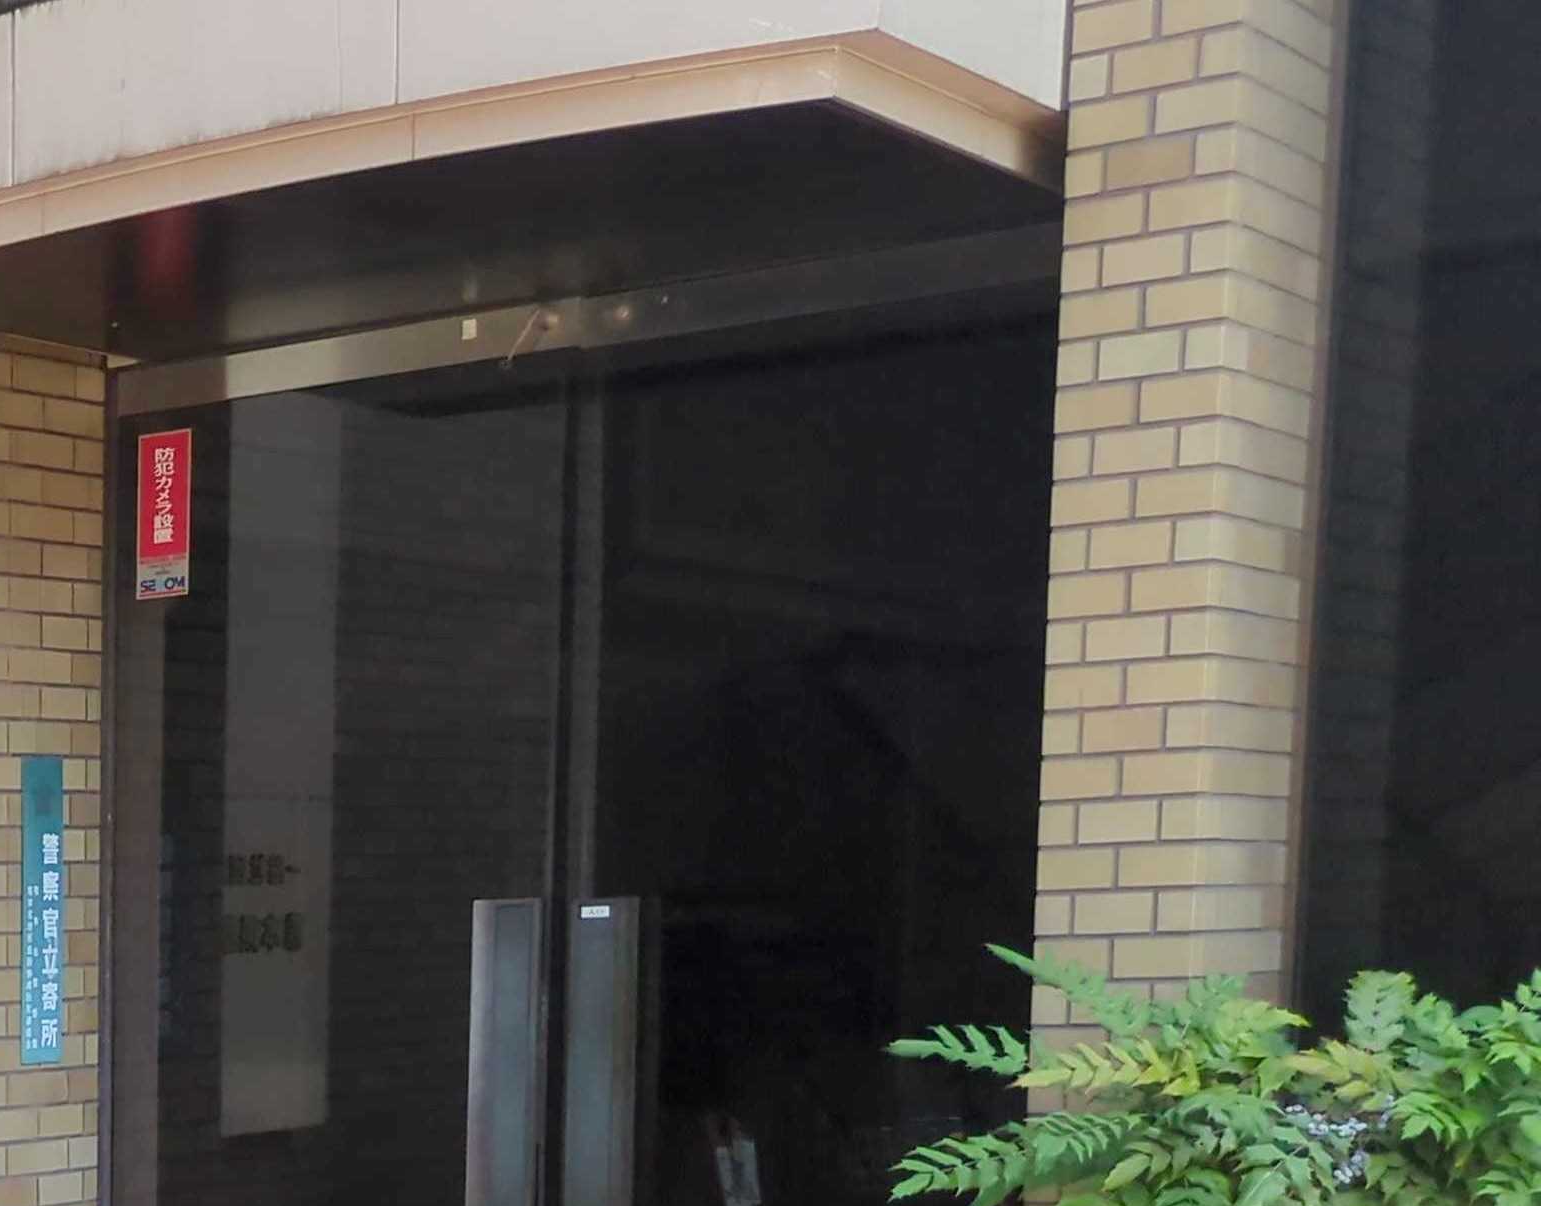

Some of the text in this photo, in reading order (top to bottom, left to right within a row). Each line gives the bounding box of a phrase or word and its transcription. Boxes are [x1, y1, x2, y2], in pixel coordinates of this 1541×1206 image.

[42, 833, 59, 1048] 警察官立寄所
